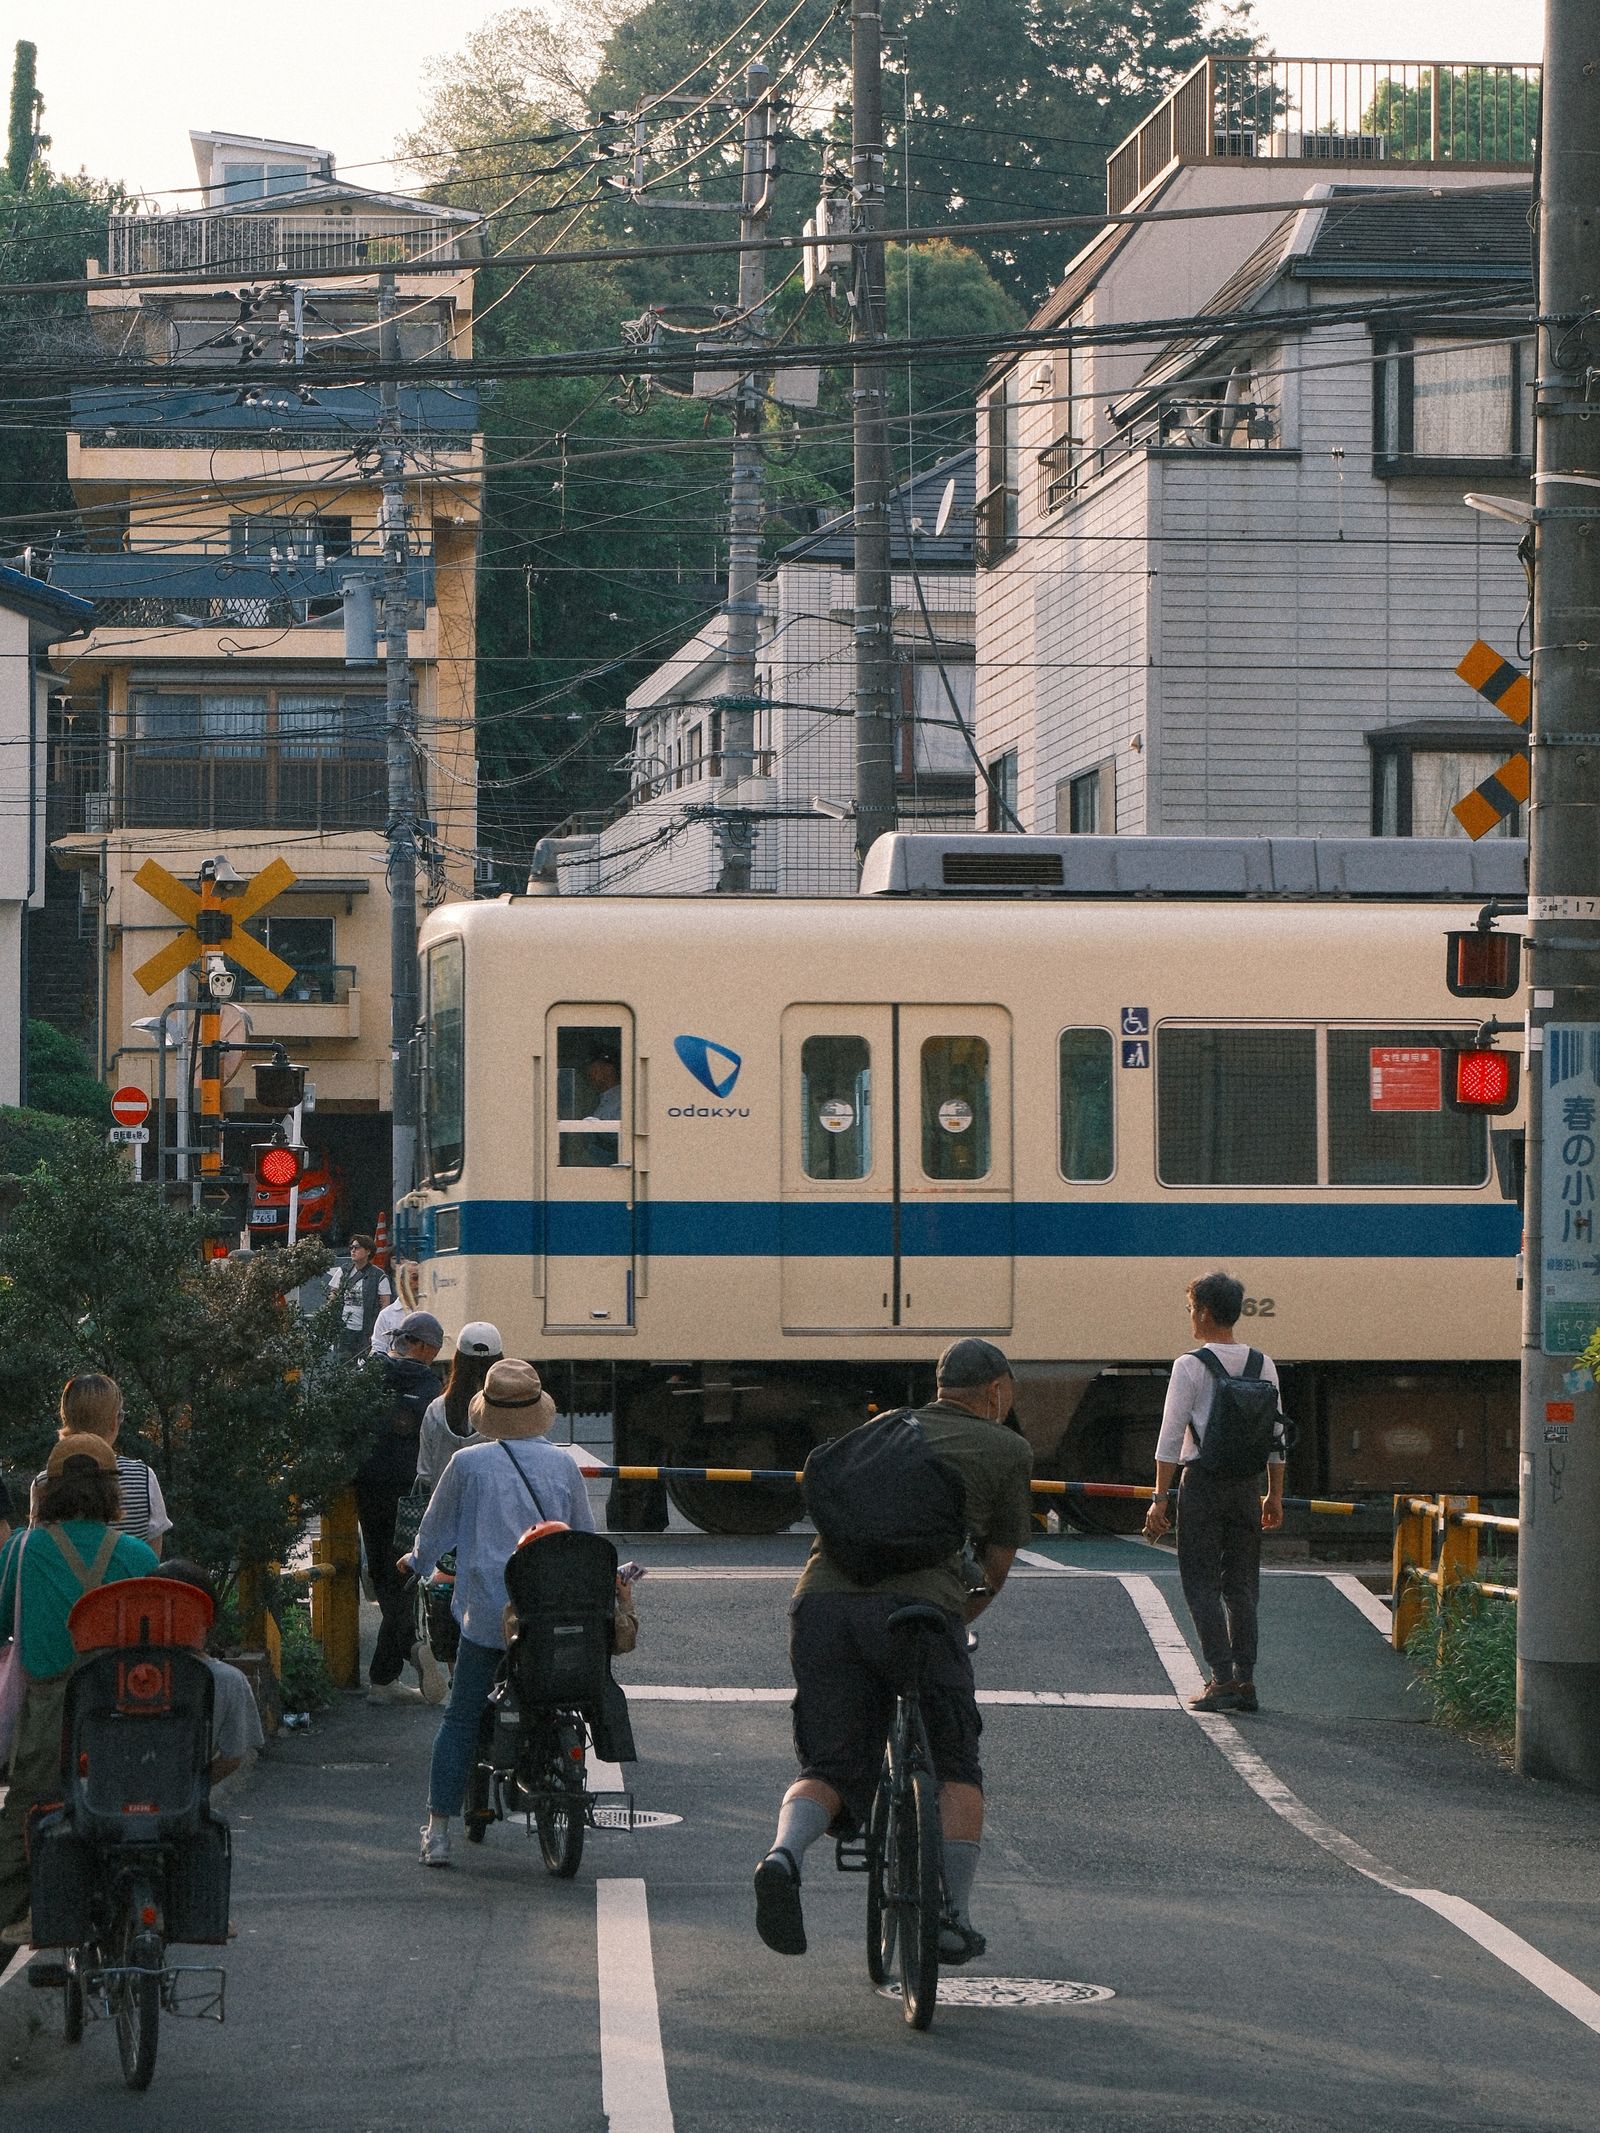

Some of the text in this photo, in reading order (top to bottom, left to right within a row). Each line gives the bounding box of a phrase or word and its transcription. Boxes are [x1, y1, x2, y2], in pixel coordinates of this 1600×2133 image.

[668, 1104, 750, 1117] odakyu
[1562, 1095, 1596, 1243] 春の小川
